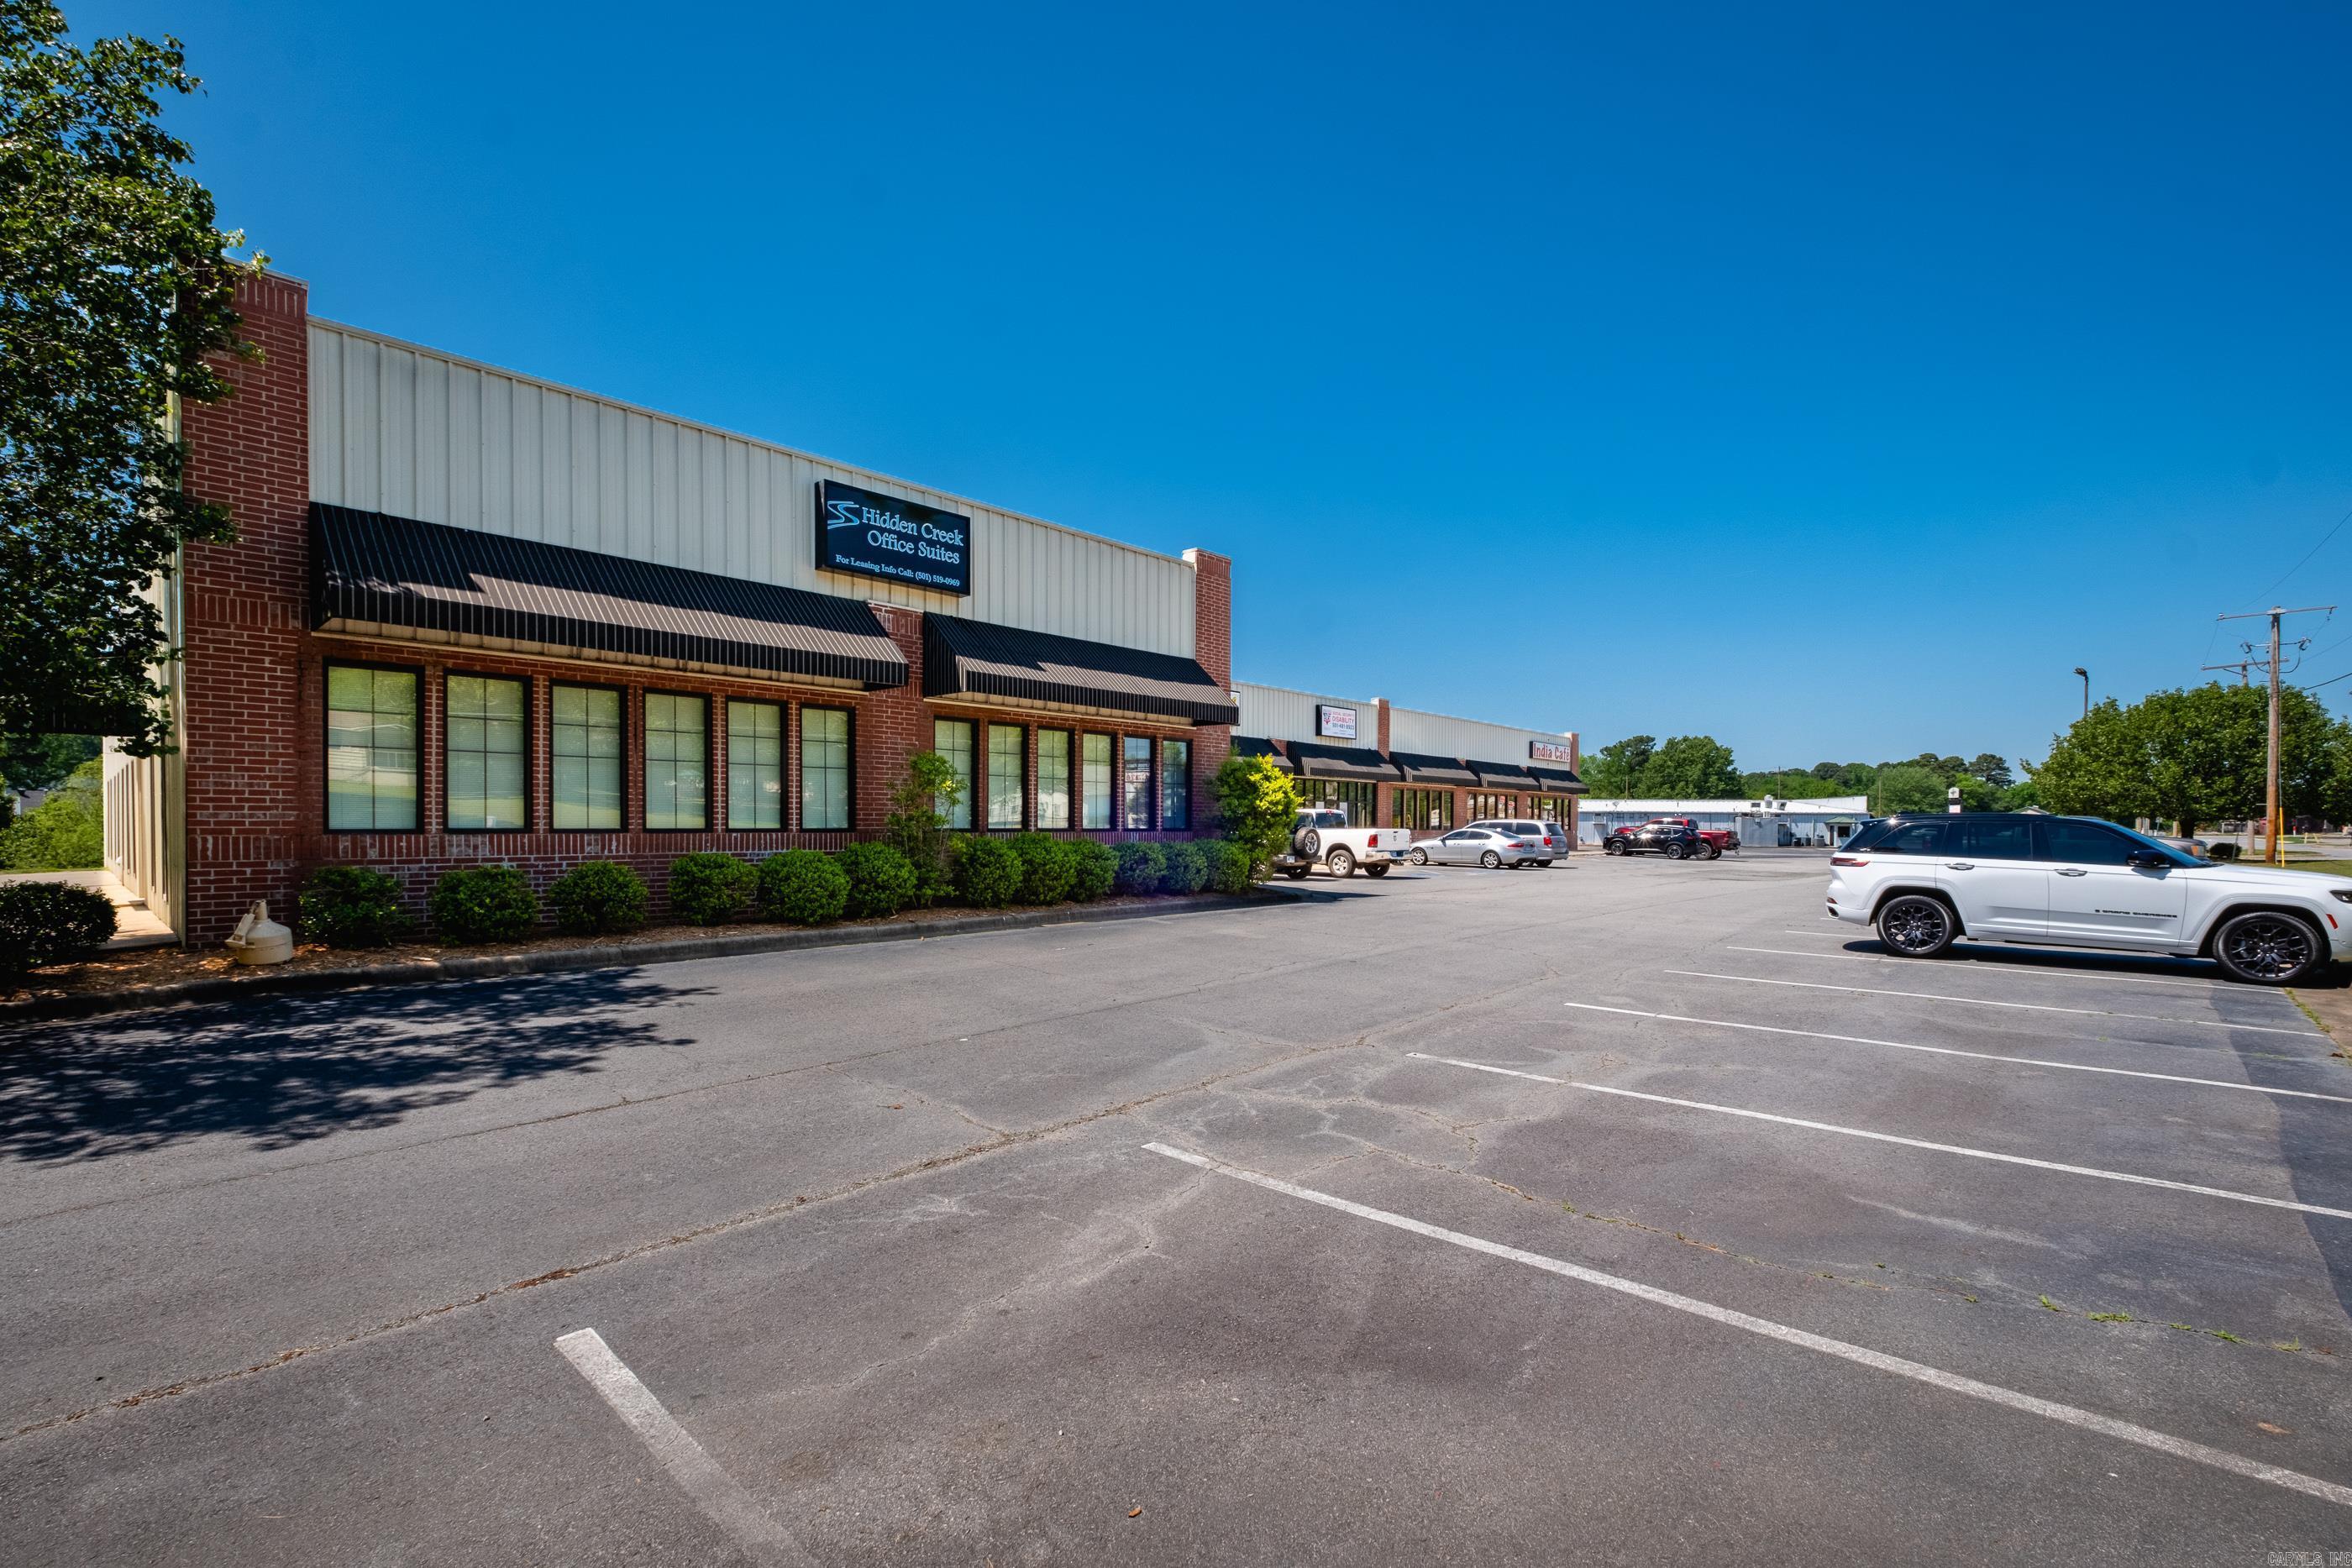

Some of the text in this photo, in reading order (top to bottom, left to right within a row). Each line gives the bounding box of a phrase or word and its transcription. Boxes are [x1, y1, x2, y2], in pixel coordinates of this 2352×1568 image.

[862, 507, 963, 546] Hidden Creek
[868, 531, 960, 564] Office Suites
[836, 554, 849, 564] For
[851, 558, 880, 572] Leasing
[882, 564, 896, 574] Info
[898, 568, 914, 577] Call:
[916, 571, 932, 582] (501)
[1534, 742, 1552, 758] India
